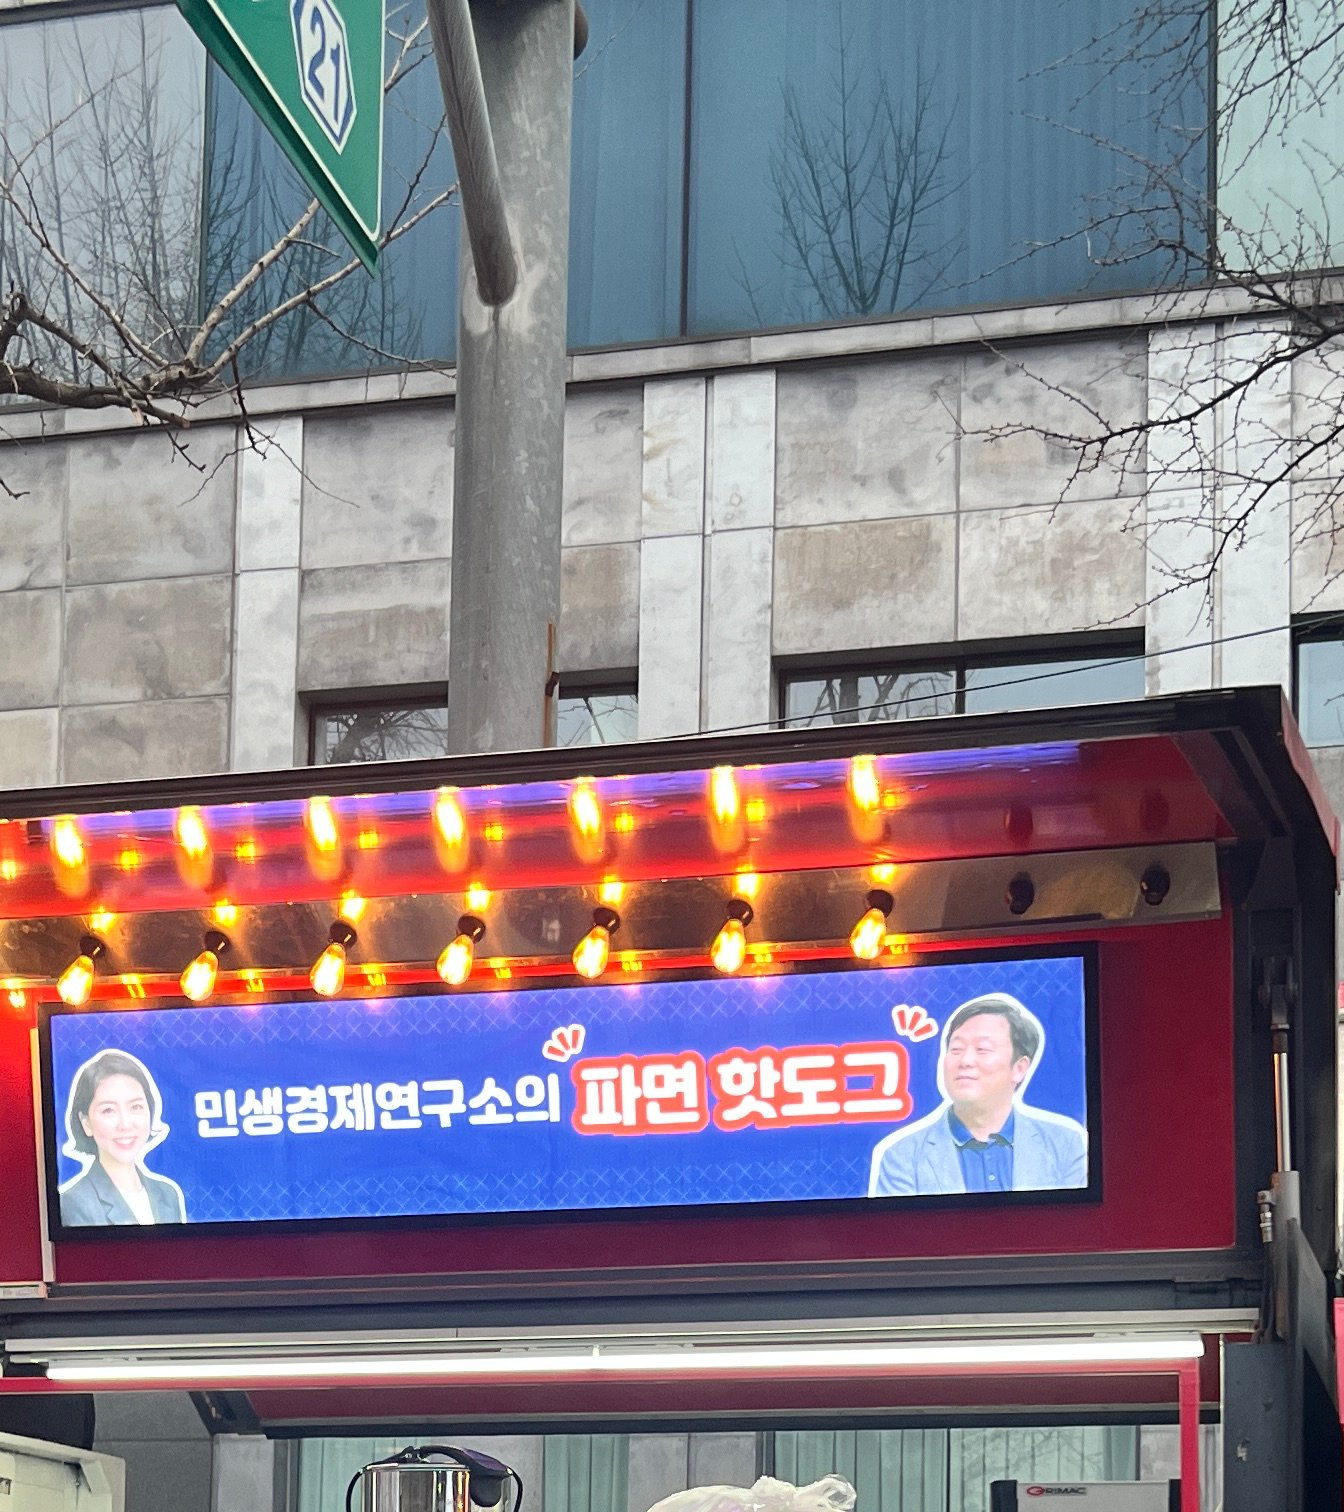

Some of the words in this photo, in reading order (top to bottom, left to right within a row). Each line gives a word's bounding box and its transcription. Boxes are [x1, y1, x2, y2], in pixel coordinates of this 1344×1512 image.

[307, 5, 343, 128] 21
[193, 1073, 562, 1138] 민생경제연구소의
[577, 1058, 700, 1126] 파면
[718, 1047, 907, 1124] 핫도그
